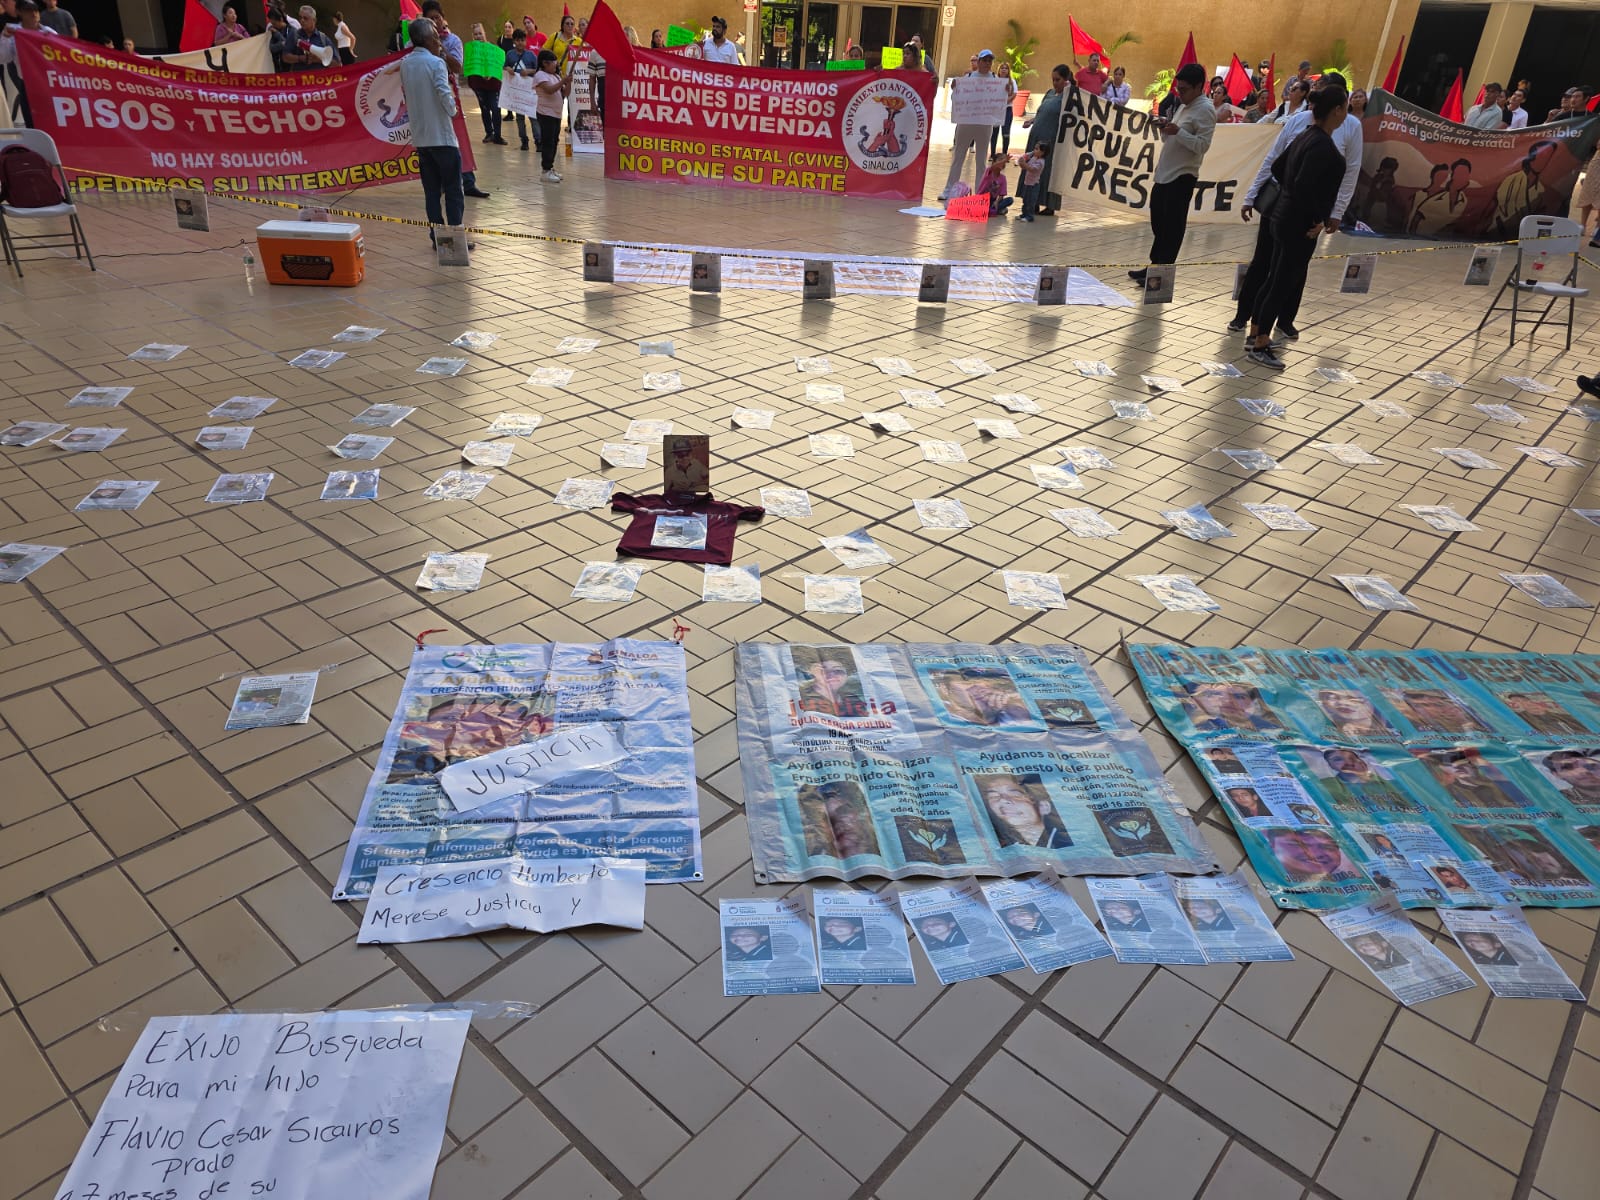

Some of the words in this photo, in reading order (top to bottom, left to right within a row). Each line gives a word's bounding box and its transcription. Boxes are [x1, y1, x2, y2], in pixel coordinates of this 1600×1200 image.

[42, 44, 67, 62] Sr.
[70, 48, 180, 80] Gobernador
[245, 75, 297, 87] Rocha
[301, 74, 347, 87] Moya.
[633, 62, 735, 88] INALOENSES
[738, 76, 838, 97] APORTAMOS
[47, 70, 112, 91] Fuimos
[116, 81, 194, 101] censados
[198, 88, 239, 103] hace
[243, 94, 264, 104] un
[268, 92, 298, 104] año
[302, 88, 337, 105] para
[622, 79, 727, 109] MILLONES
[734, 92, 761, 112] DE
[767, 96, 836, 118] PESOS
[52, 96, 175, 131] PISOS
[193, 105, 346, 135] TECHOS
[621, 101, 693, 126] PARA
[702, 109, 833, 139] VIVIENDA
[845, 82, 887, 136] MOVIMIENTO
[888, 82, 925, 142] ANTORCHISTA
[1064, 84, 1164, 143] ANTOR
[1384, 101, 1456, 133] Desplazados
[388, 130, 413, 142] SINA
[1057, 114, 1155, 172] POPULA
[1379, 120, 1407, 132] para
[1409, 124, 1418, 137] el
[1420, 129, 1470, 146] gobierno
[1472, 137, 1515, 149] estatal
[151, 152, 176, 168] NO
[181, 153, 214, 169] HAY
[221, 149, 308, 169] SOLUCIÓN.
[617, 134, 706, 155] GOBIERNO
[711, 144, 782, 163] ESTATAL
[788, 151, 850, 172] (CVIVE)
[862, 160, 899, 171] SINALOA
[213, 175, 249, 193] SU
[256, 151, 421, 192] INTERVENCIÓ
[619, 153, 653, 173] NO
[661, 157, 725, 180] PONE
[732, 165, 764, 184] SU
[771, 168, 846, 192] PARTE
[1070, 153, 1238, 212] PRESTE
[607, 649, 659, 659] SINALOA
[430, 685, 495, 695] CRESENCIO
[790, 715, 820, 729] JULIO
[857, 719, 893, 729] PULIDO
[466, 734, 604, 796] JUSTICIA
[860, 759, 869, 768] a
[873, 756, 932, 769] localizar
[960, 764, 1000, 775] Javier
[1002, 764, 1054, 775] Ernesto
[979, 751, 1045, 762] Ayúdanos
[1046, 751, 1055, 759] a
[1056, 750, 1111, 761] localizar
[792, 772, 841, 783] Ernesto
[886, 769, 935, 781] Chavira
[1063, 773, 1126, 783] Desaparecido
[927, 808, 951, 816] años
[363, 846, 378, 856] Si
[432, 840, 513, 852] información
[384, 868, 504, 896] Cresencio
[516, 864, 609, 883] Humberto
[371, 907, 448, 929] Merese
[465, 893, 542, 917] Justicia
[145, 1029, 240, 1064] EXIJO
[275, 1021, 423, 1062] Busqueda
[124, 1073, 180, 1098] Para
[205, 1075, 237, 1099] mi
[265, 1066, 319, 1092] hijo
[93, 1116, 184, 1157] Flavio
[198, 1119, 271, 1149] Cesar
[288, 1116, 400, 1143] Sicairos
[152, 1153, 235, 1183] Prado
[198, 1180, 231, 1200] de
[250, 1178, 277, 1195] su
